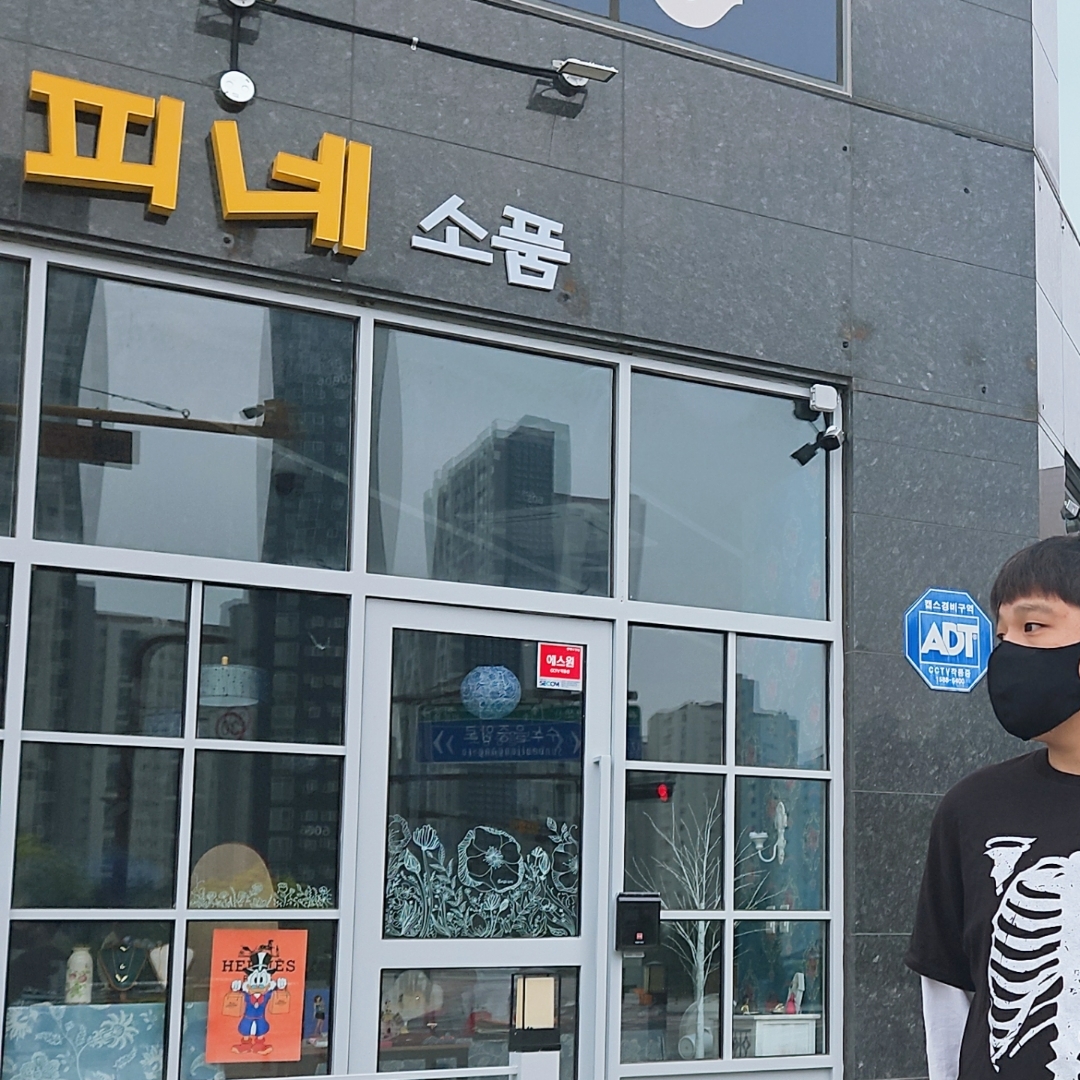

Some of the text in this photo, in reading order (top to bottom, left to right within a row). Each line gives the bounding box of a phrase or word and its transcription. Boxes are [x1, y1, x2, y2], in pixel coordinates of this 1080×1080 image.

[24, 70, 571, 291] 피네 소품
[920, 621, 979, 658] ADT
[546, 654, 575, 668] 에스원
[222, 958, 296, 972] HEÈS
